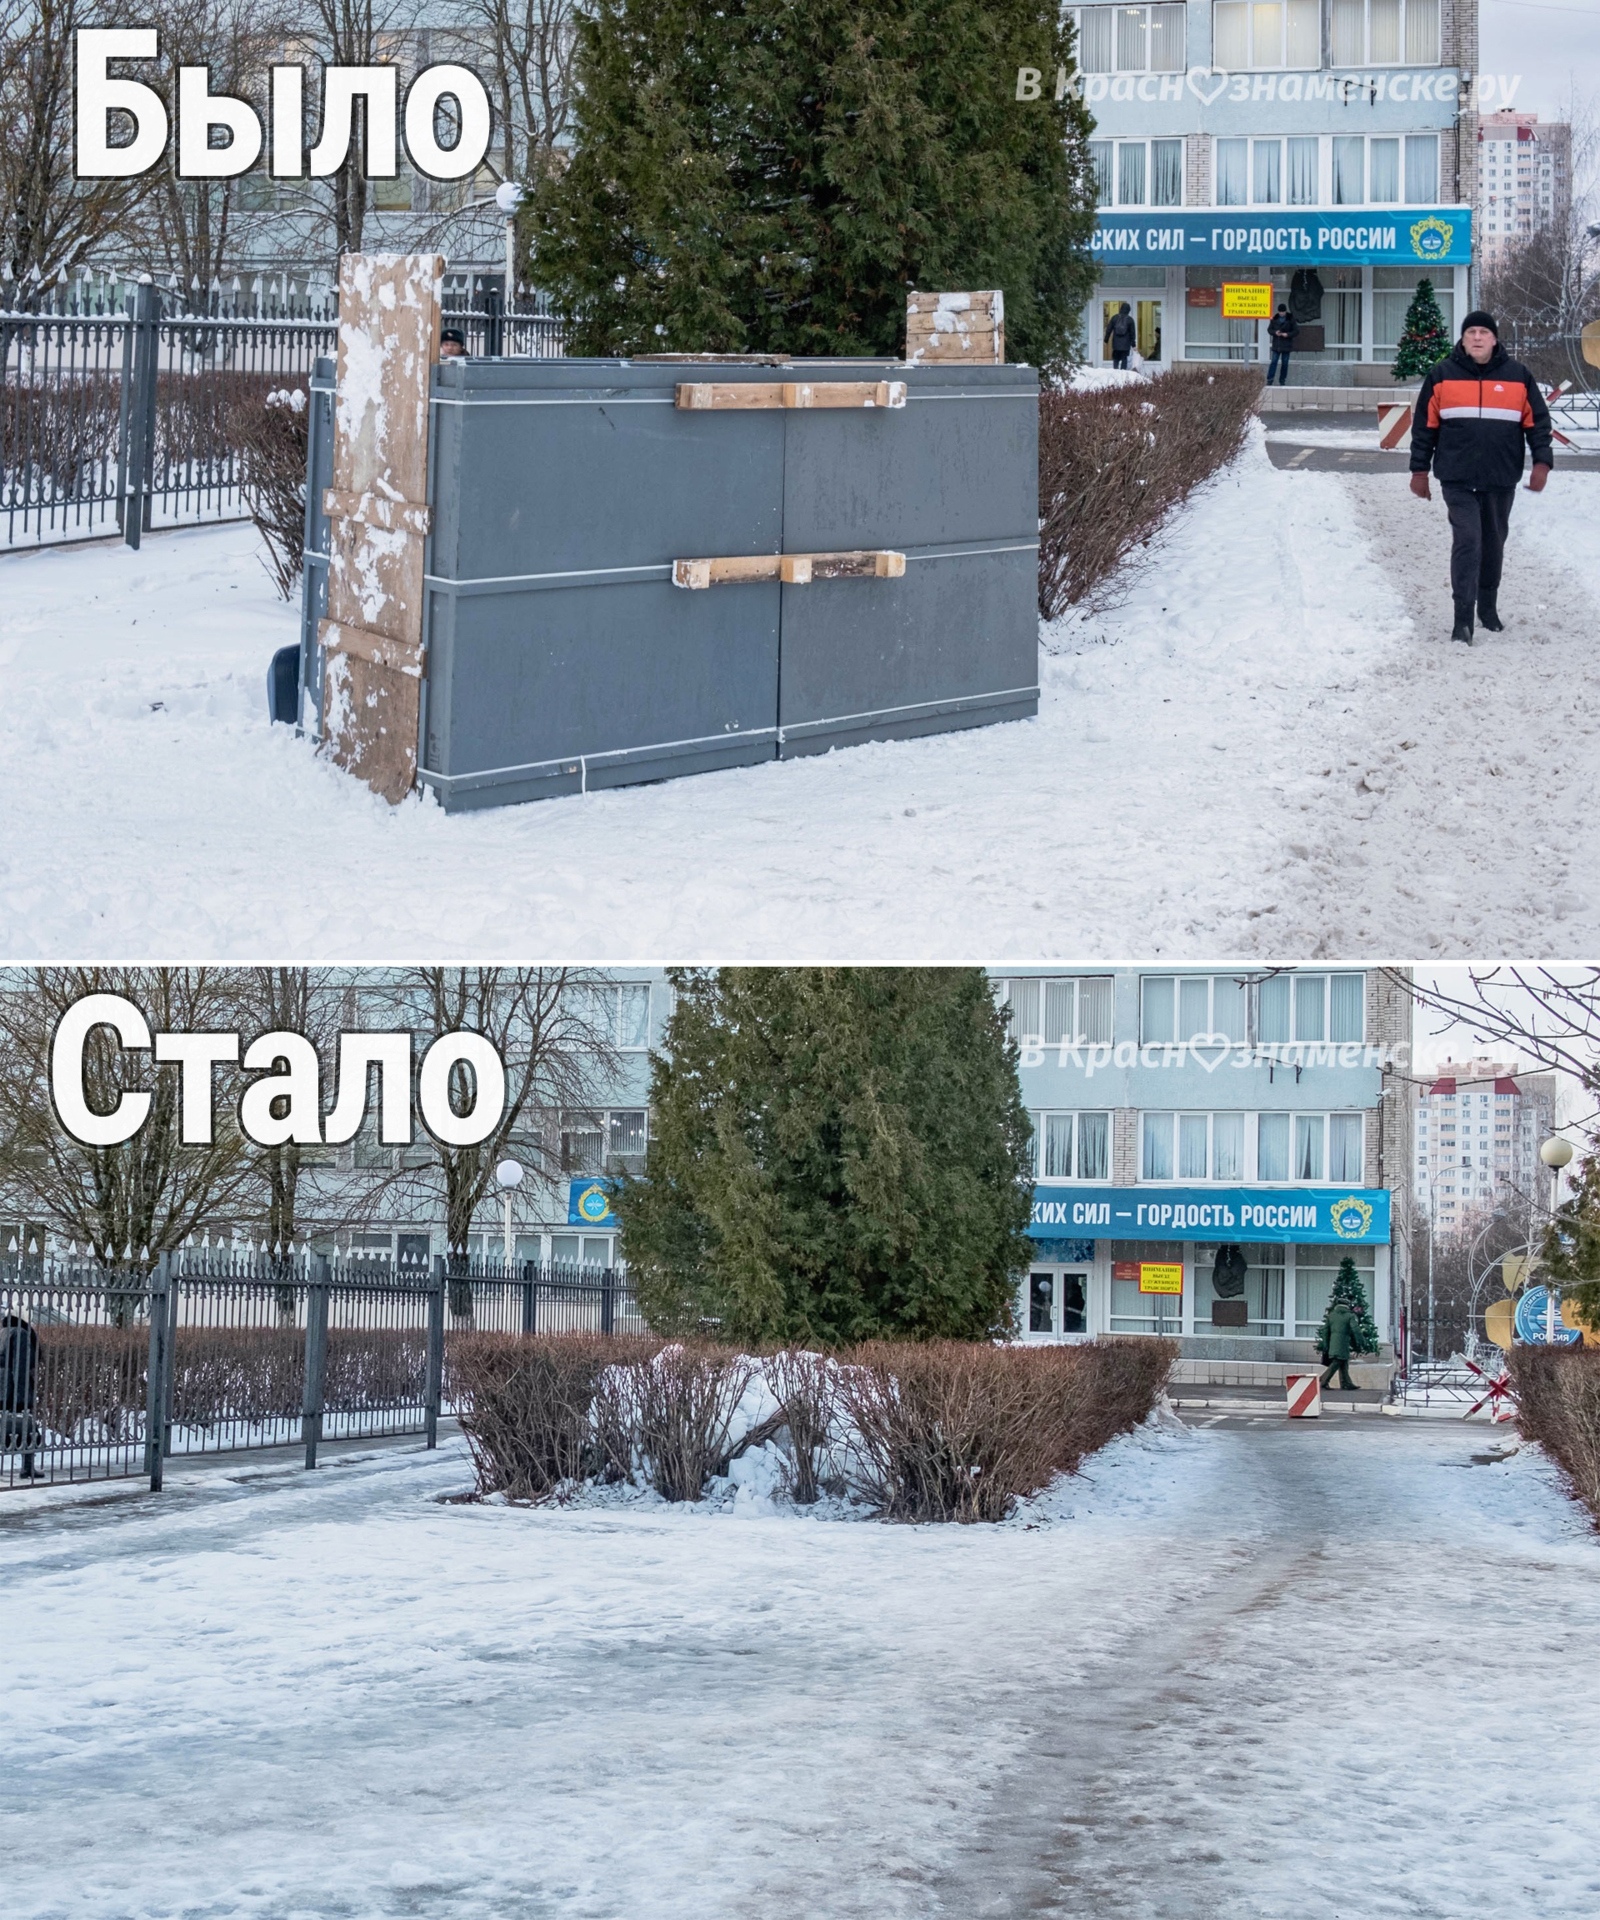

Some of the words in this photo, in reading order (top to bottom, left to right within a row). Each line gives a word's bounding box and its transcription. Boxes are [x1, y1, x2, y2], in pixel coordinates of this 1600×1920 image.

[1146, 228, 1184, 251] СИЛ
[1212, 227, 1312, 253] ГОРДОСТЬ
[1318, 227, 1396, 251] РОССИИ
[1073, 1202, 1110, 1225] СИЛ
[1136, 1203, 1235, 1229] ГОРДОСТЬ
[1241, 1205, 1317, 1228] РОССИИ
